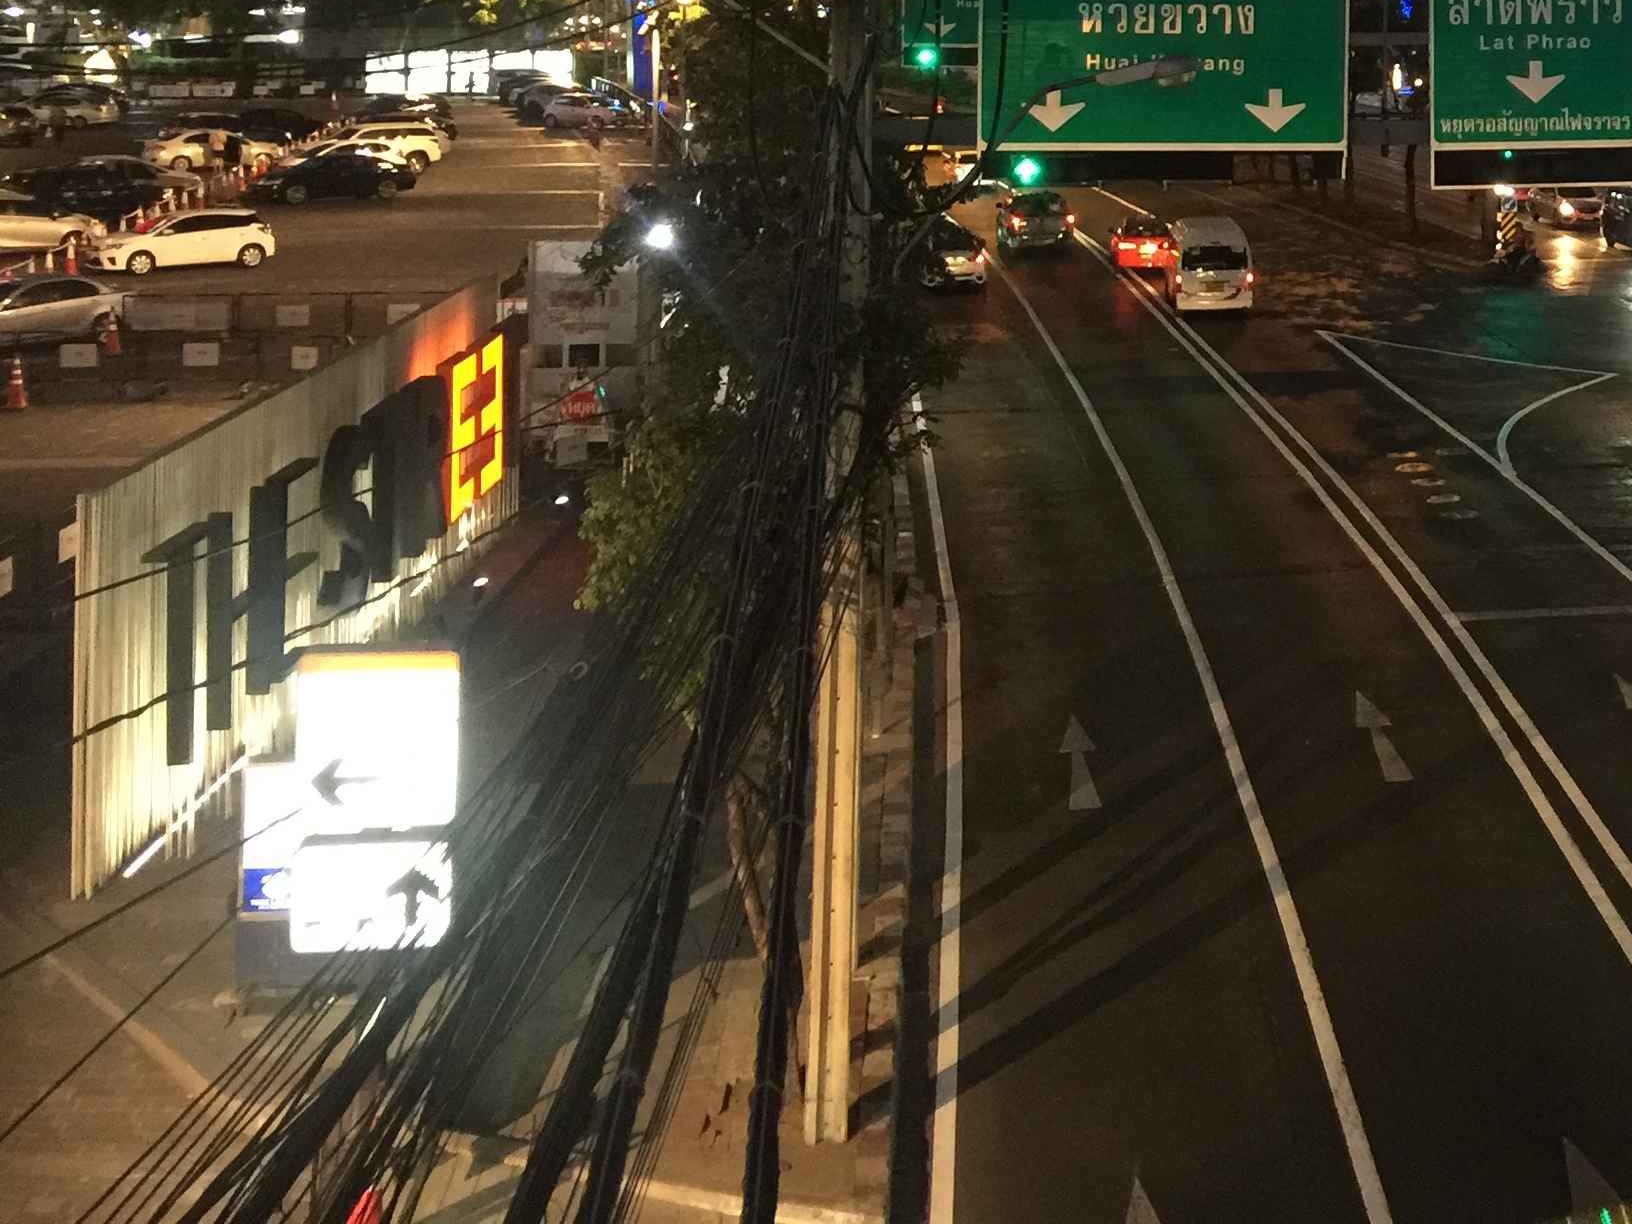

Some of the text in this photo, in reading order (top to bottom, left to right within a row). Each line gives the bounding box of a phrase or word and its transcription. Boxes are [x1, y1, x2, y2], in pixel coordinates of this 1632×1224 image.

[1479, 34, 1592, 51] Lat Phrao
[1440, 107, 1631, 139] หยุดรอสัญญาณไฟจราจร
